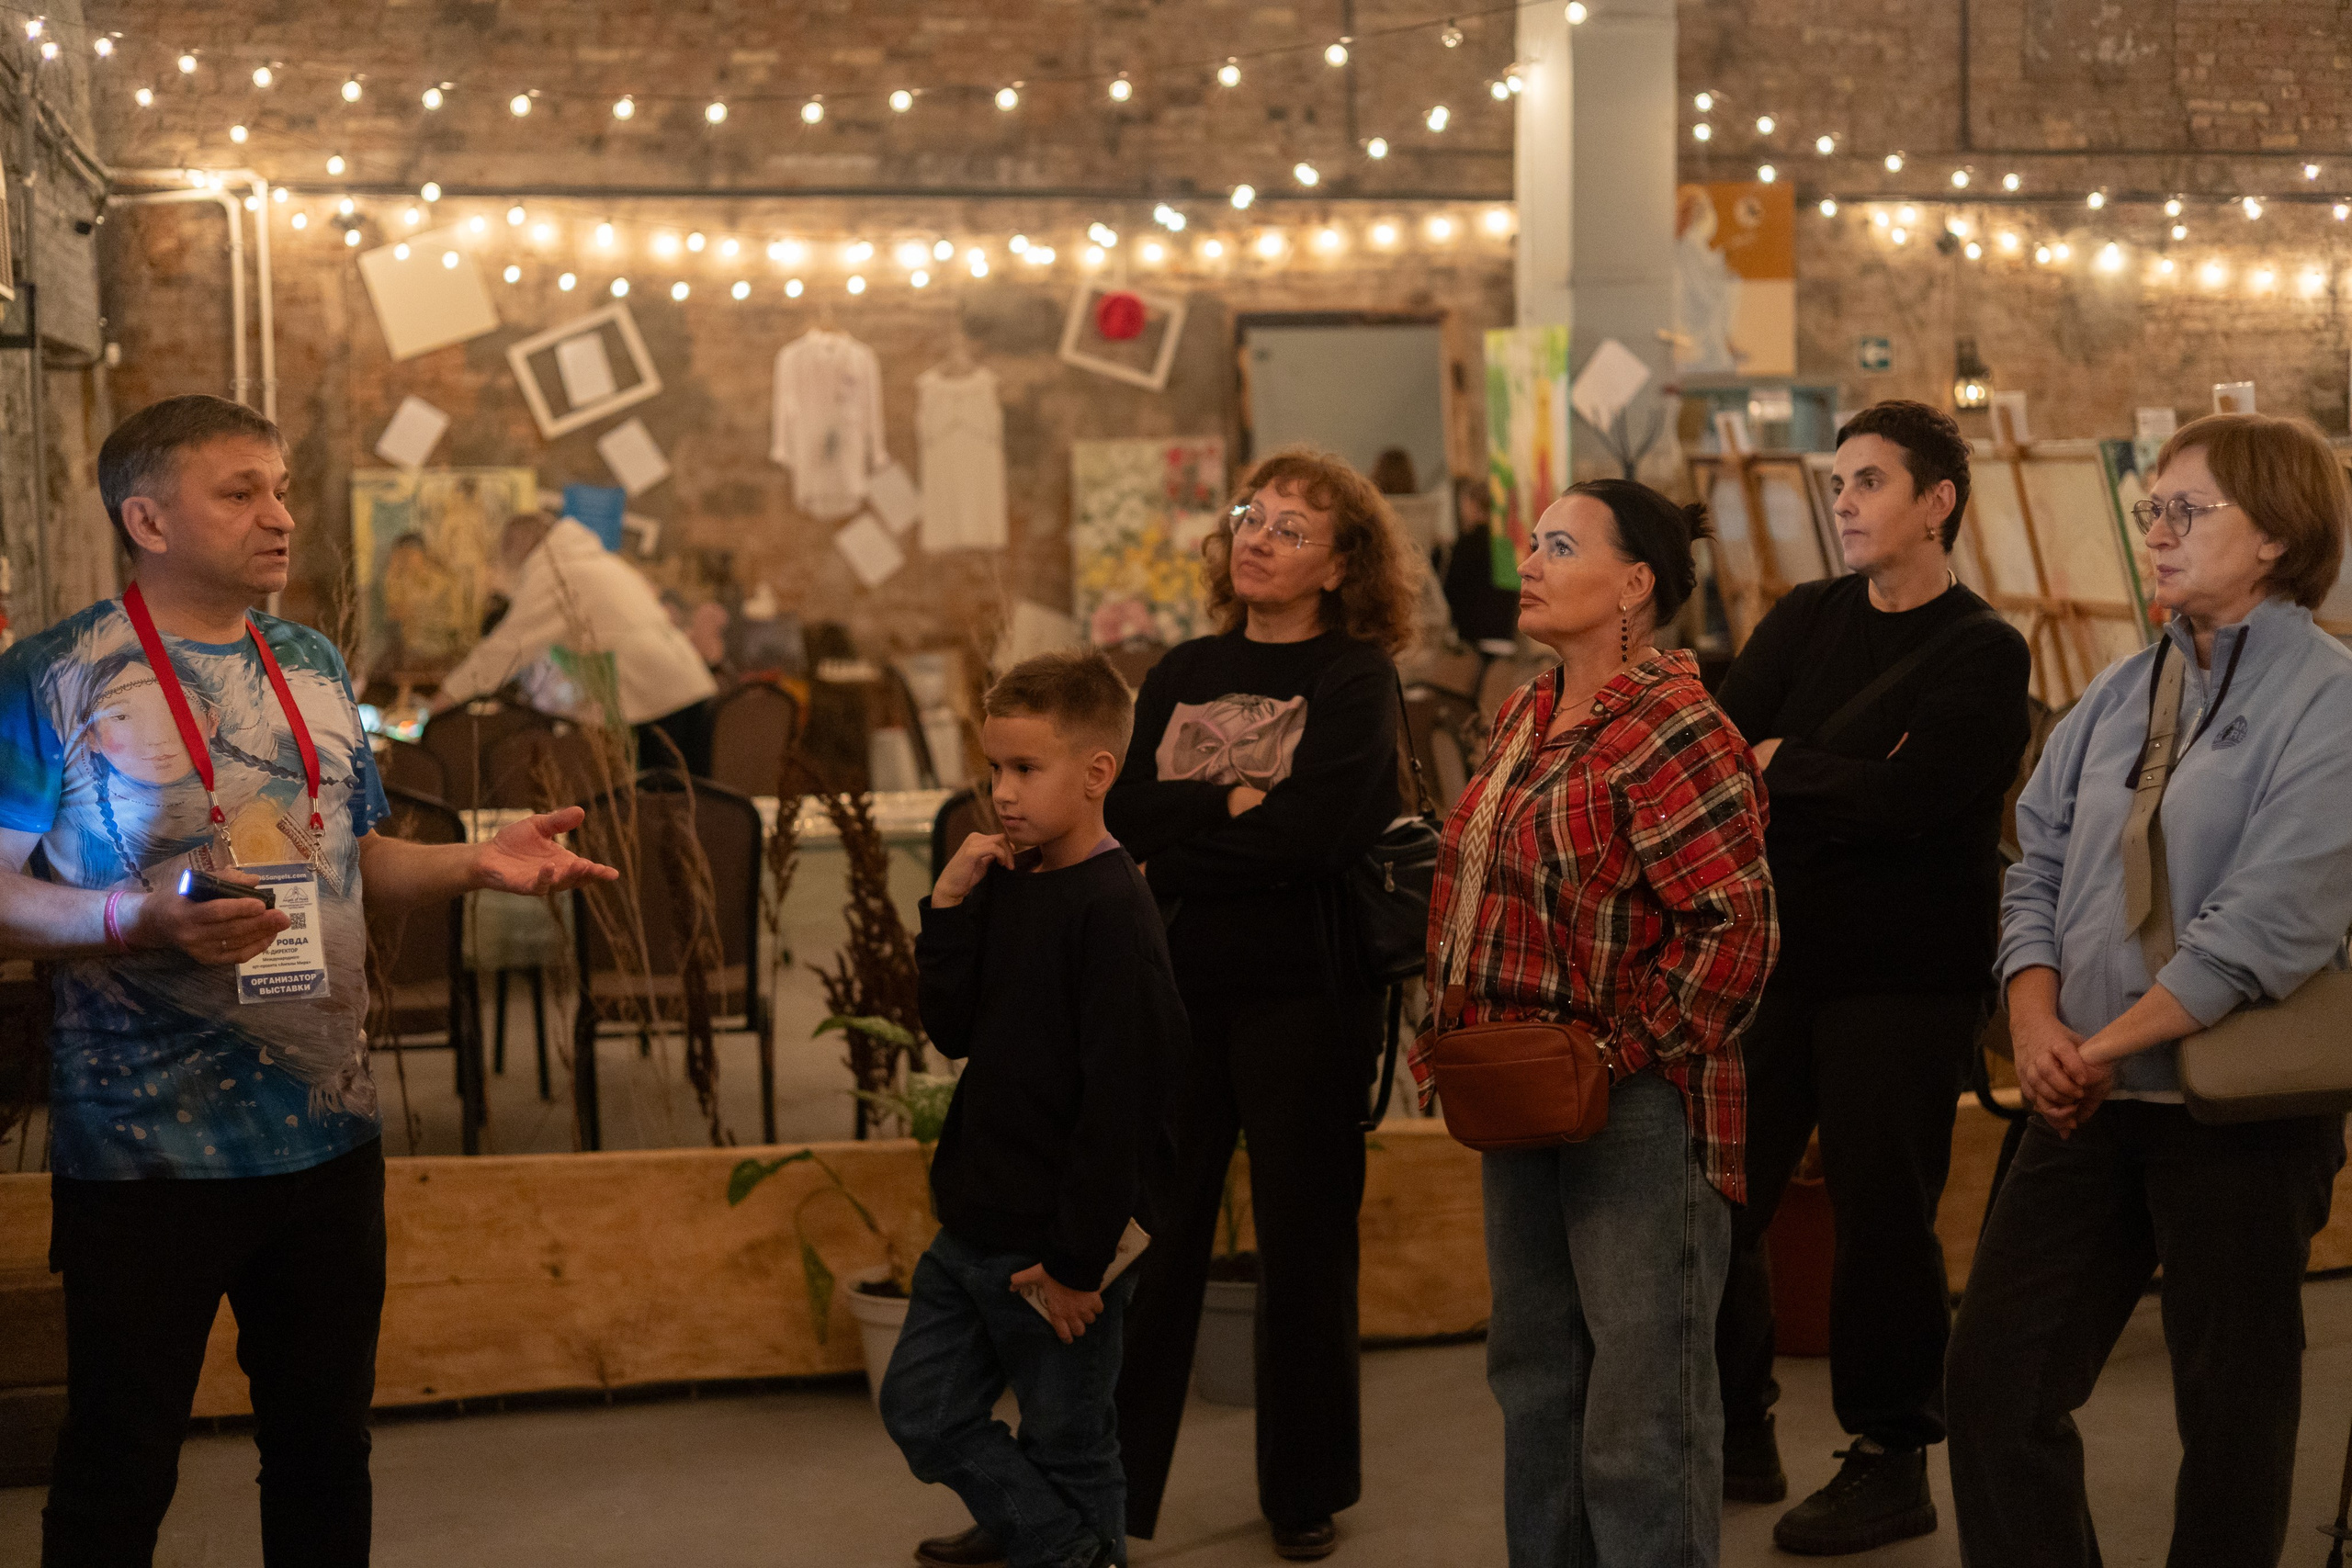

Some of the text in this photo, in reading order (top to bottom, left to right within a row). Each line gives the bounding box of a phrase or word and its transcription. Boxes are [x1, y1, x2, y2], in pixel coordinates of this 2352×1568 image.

[277, 937, 309, 946] РОВДА
[251, 974, 317, 986] ОРГАНИЗАТОР
[259, 984, 311, 995] ВЫСТАВКИ
